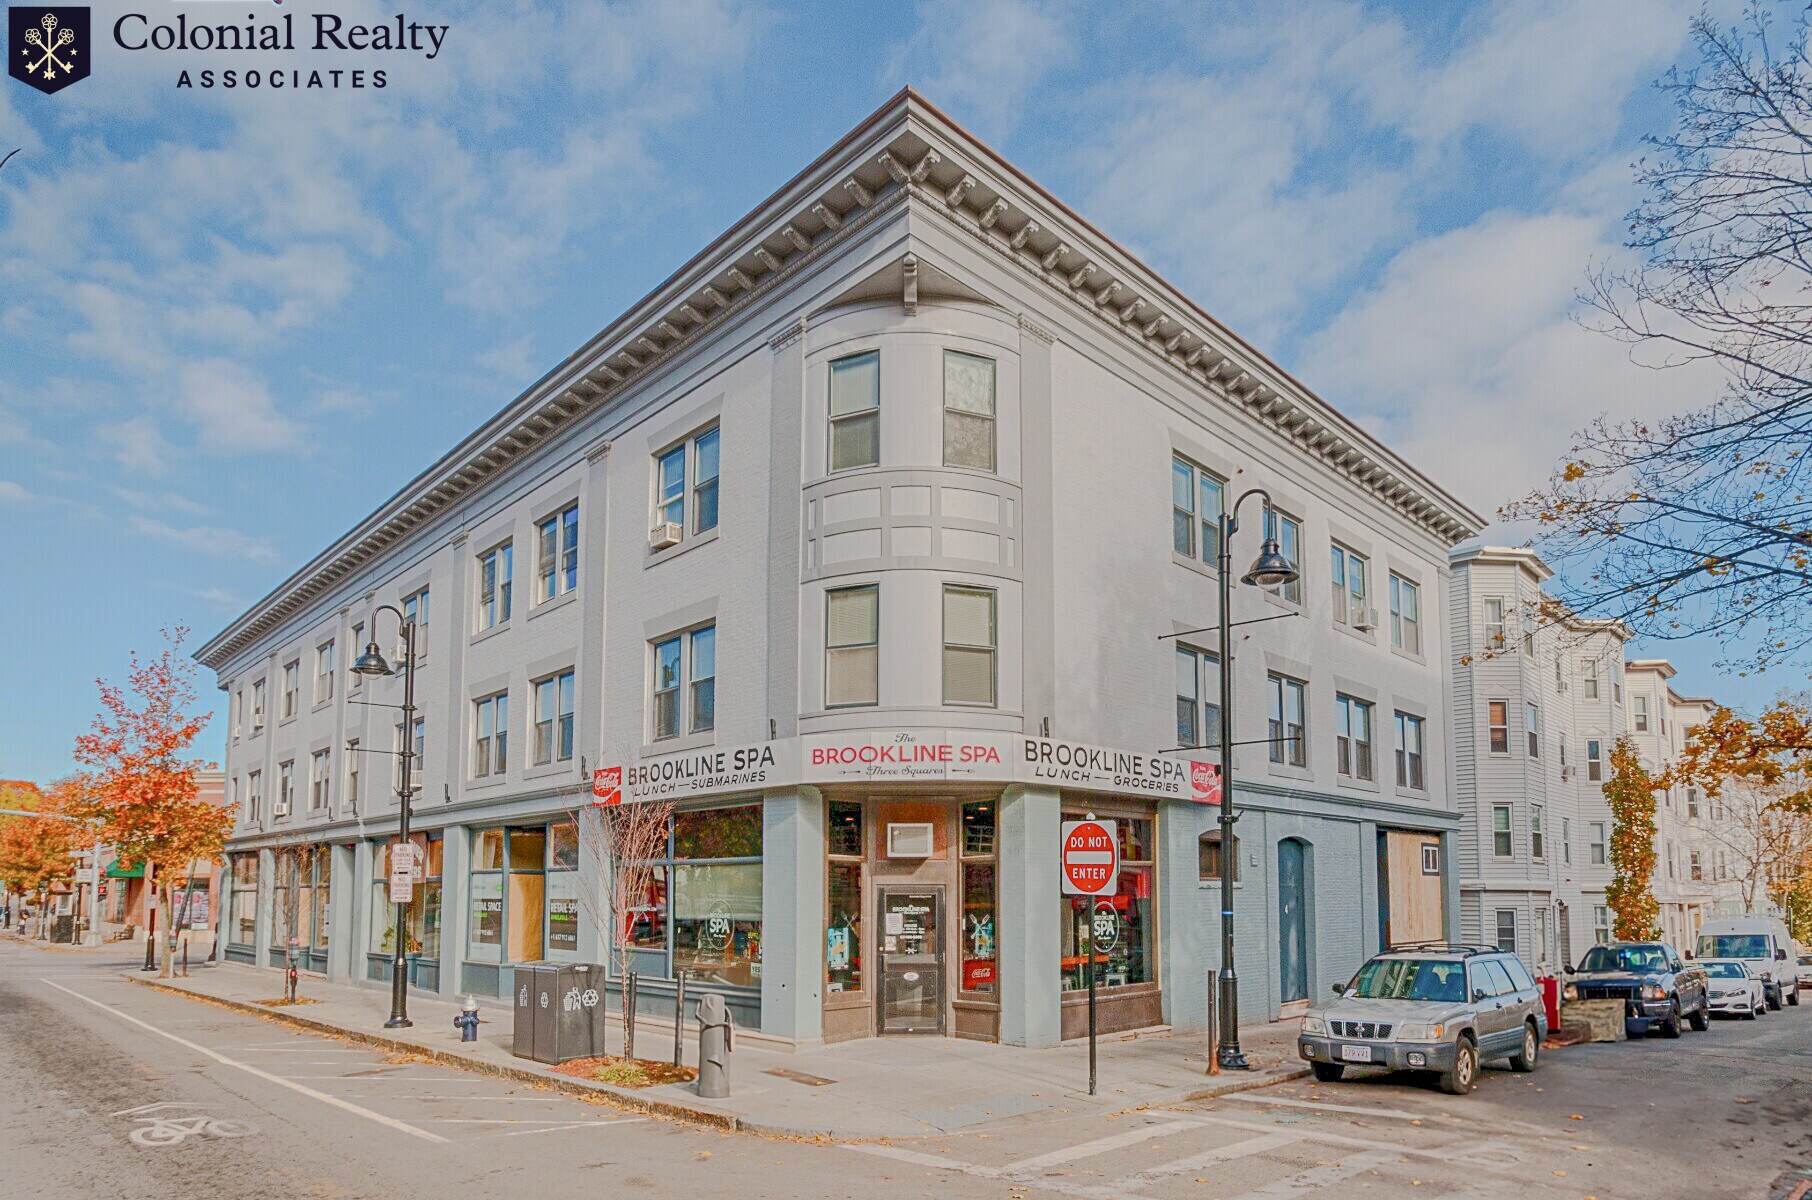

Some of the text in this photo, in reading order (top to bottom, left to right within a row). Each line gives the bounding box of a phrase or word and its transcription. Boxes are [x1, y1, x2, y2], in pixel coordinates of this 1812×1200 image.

[894, 733, 917, 743] The
[812, 745, 1001, 765] BROOKLINE SPA
[1025, 739, 1186, 782] BROOKLINE SPA
[628, 746, 775, 786] BROOKLINE SPA
[866, 765, 945, 777] Three Squares
[634, 770, 766, 797] LUNCH SUBMARINES
[1035, 766, 1179, 793] LUNCH GROCERIES
[1070, 836, 1107, 848] DO NOT
[1072, 867, 1106, 880] ENTER
[488, 901, 502, 912] SPACE
[709, 918, 730, 934] SPA
[1093, 920, 1115, 936] SPA
